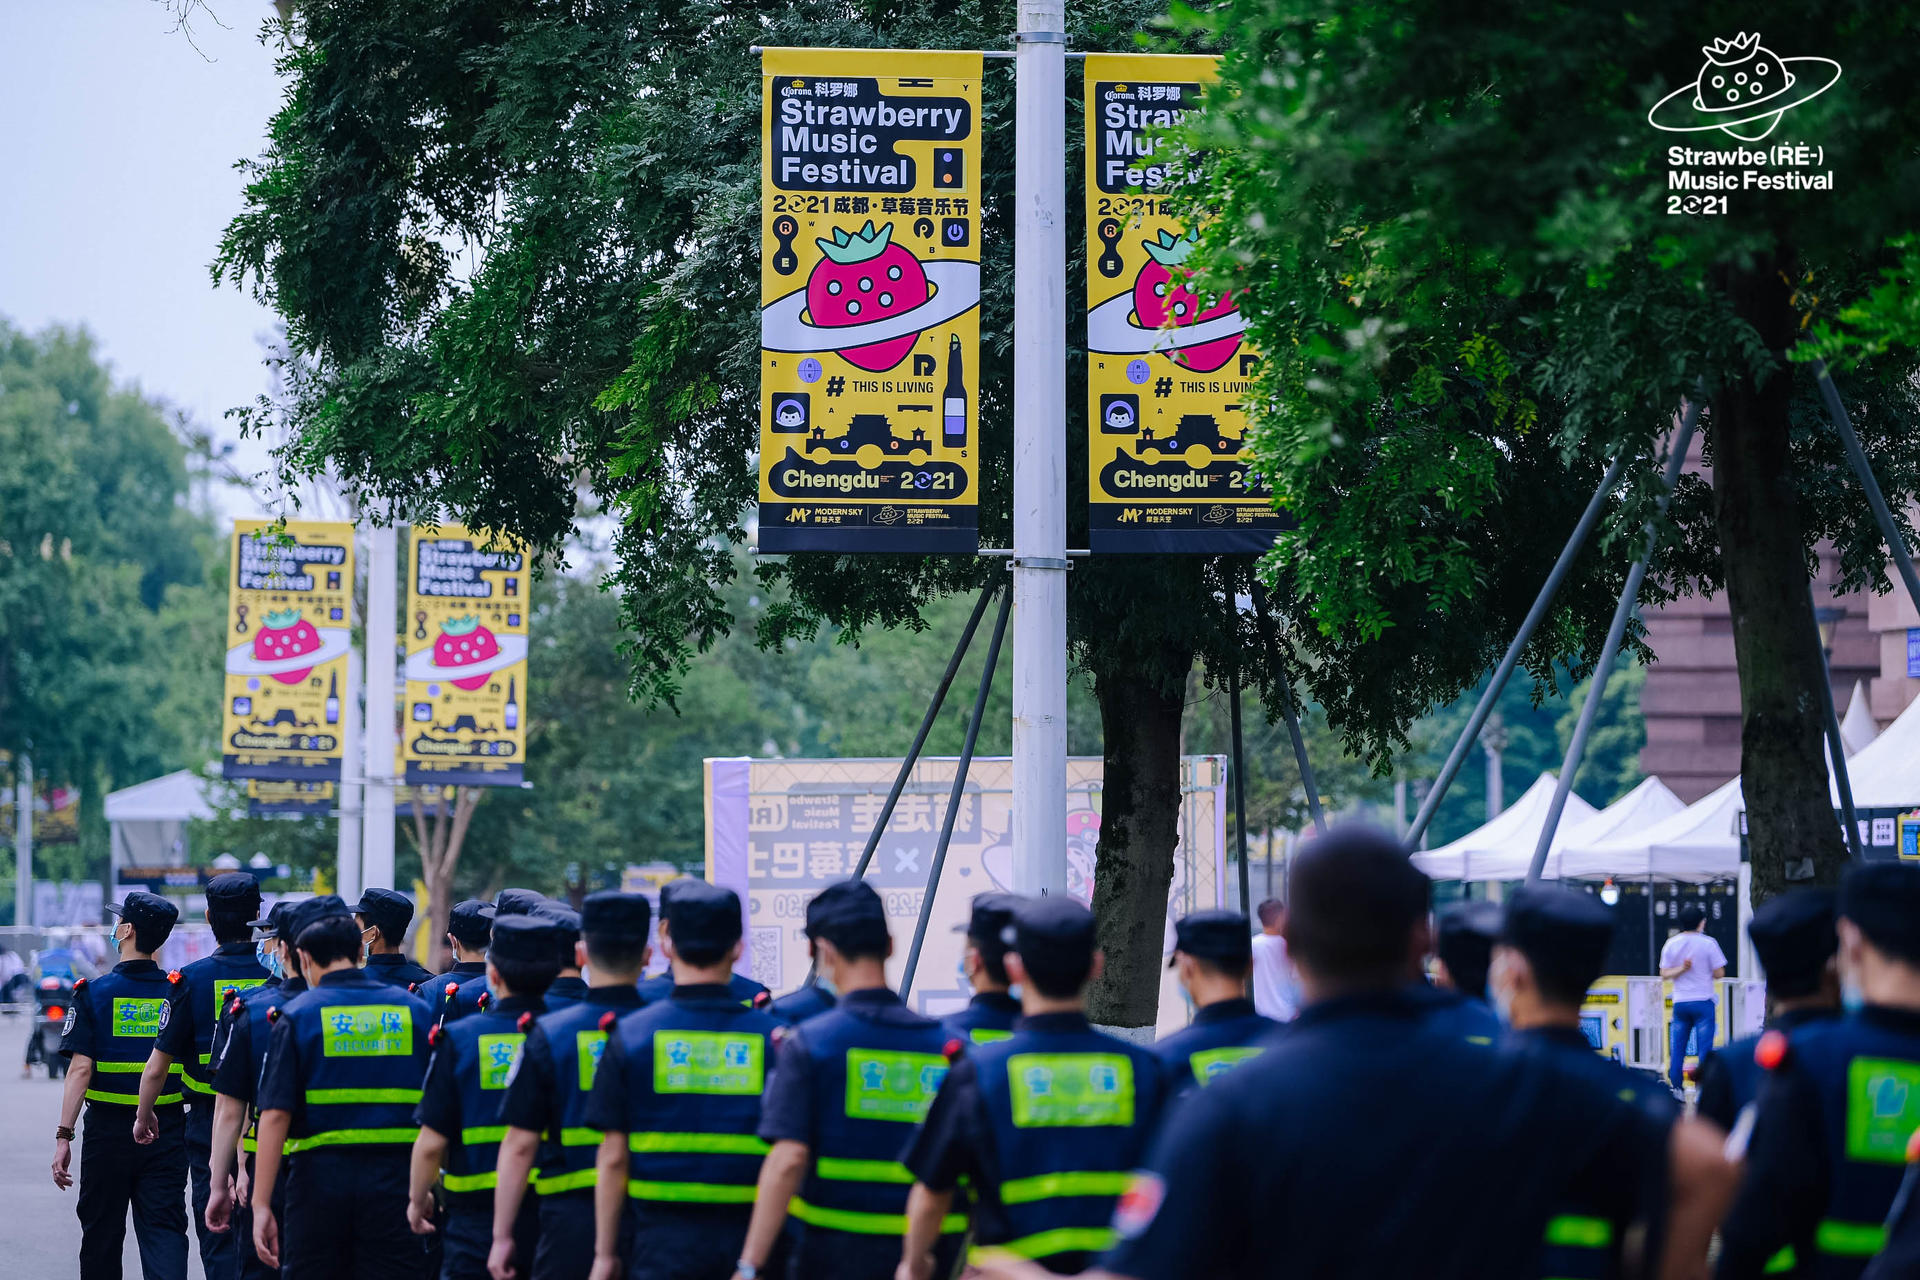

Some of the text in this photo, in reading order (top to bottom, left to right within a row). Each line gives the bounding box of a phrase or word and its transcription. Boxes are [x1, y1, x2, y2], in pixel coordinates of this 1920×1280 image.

[781, 82, 858, 97] Corona 科罗娜
[1104, 86, 1181, 101] Corona 科罗娜
[781, 98, 962, 134] Strawberry
[782, 126, 877, 153] Music
[782, 157, 907, 185] Festival
[852, 381, 878, 393] THIS
[882, 381, 893, 393] IS
[896, 382, 934, 393] LIVING
[1180, 382, 1206, 393] THIS
[1209, 382, 1219, 393] IS
[1223, 382, 1255, 393] LIVIN
[783, 469, 879, 493] Chengdu
[1114, 470, 1208, 492] Chengdu
[120, 1003, 138, 1022] 安
[121, 1025, 158, 1034] SECUR
